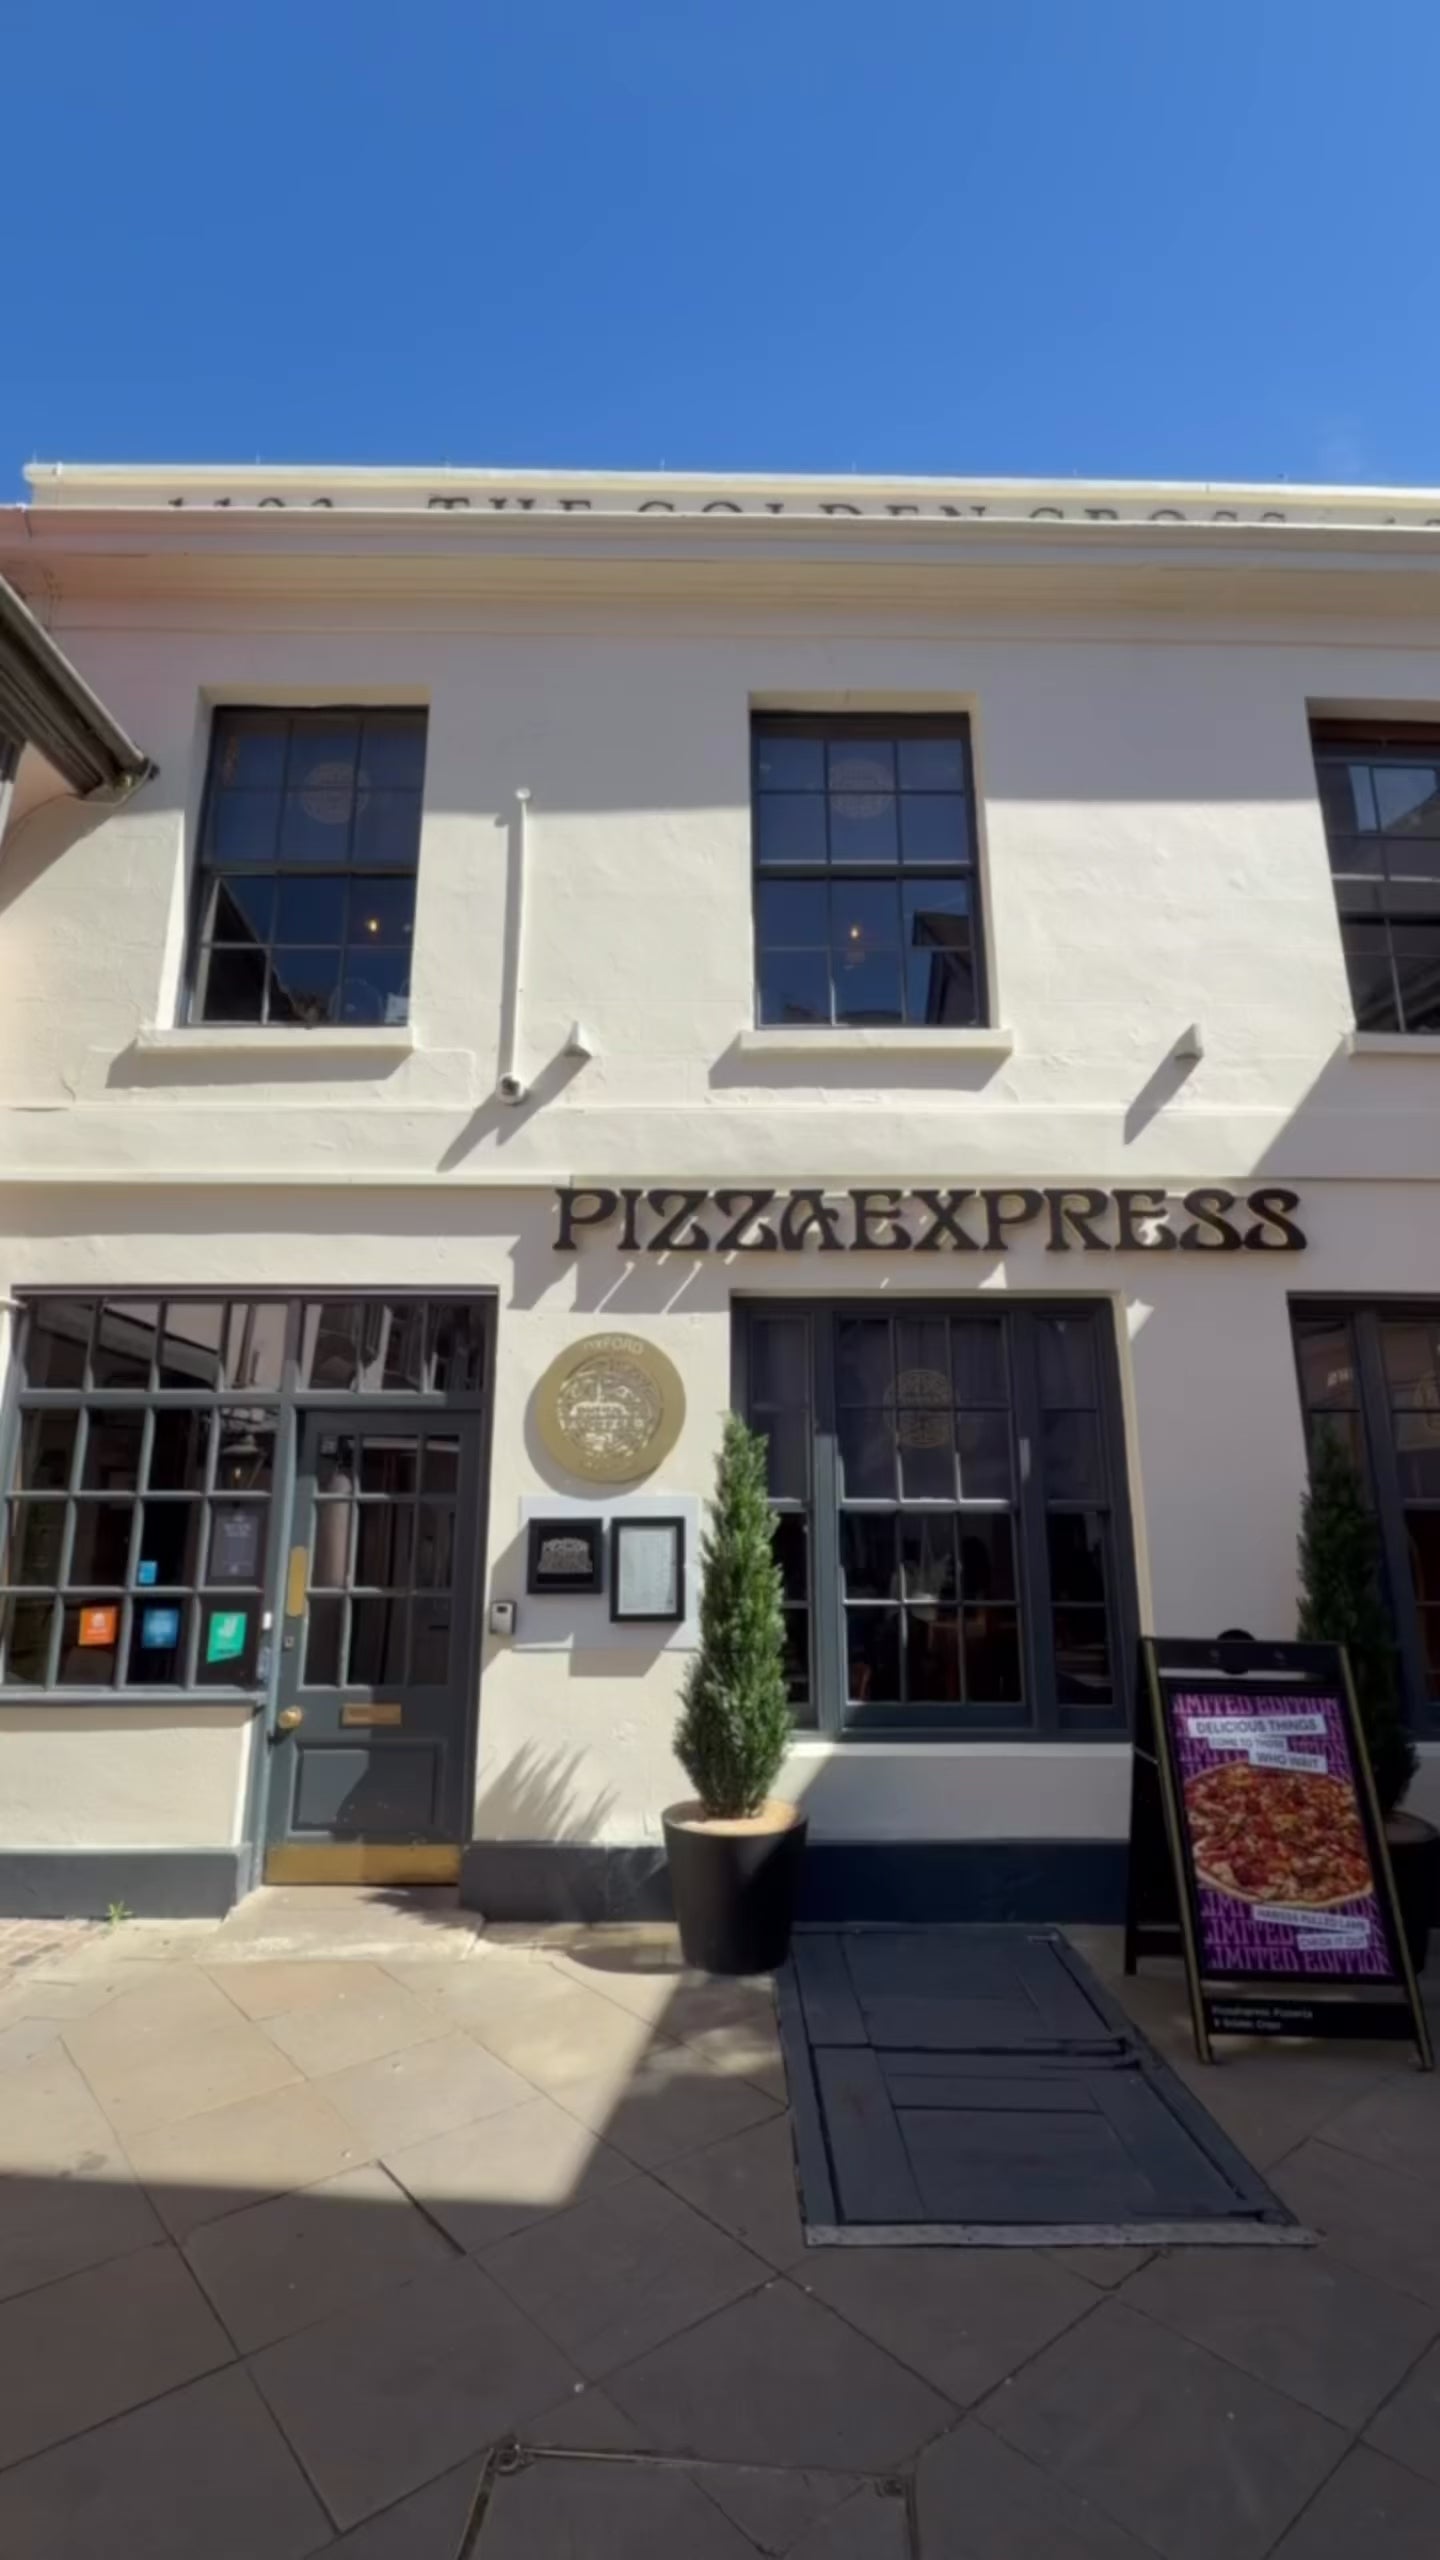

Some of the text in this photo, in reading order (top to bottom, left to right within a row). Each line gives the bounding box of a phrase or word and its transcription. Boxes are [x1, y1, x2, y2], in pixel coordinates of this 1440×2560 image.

[552, 1188, 1307, 1251] PIZZAEXPRESS
[1196, 1720, 1267, 1734] DELICIOUS
[1269, 1718, 1317, 1732] THINGS
[1257, 1751, 1285, 1765] WHO
[1288, 1755, 1318, 1769] WAIT
